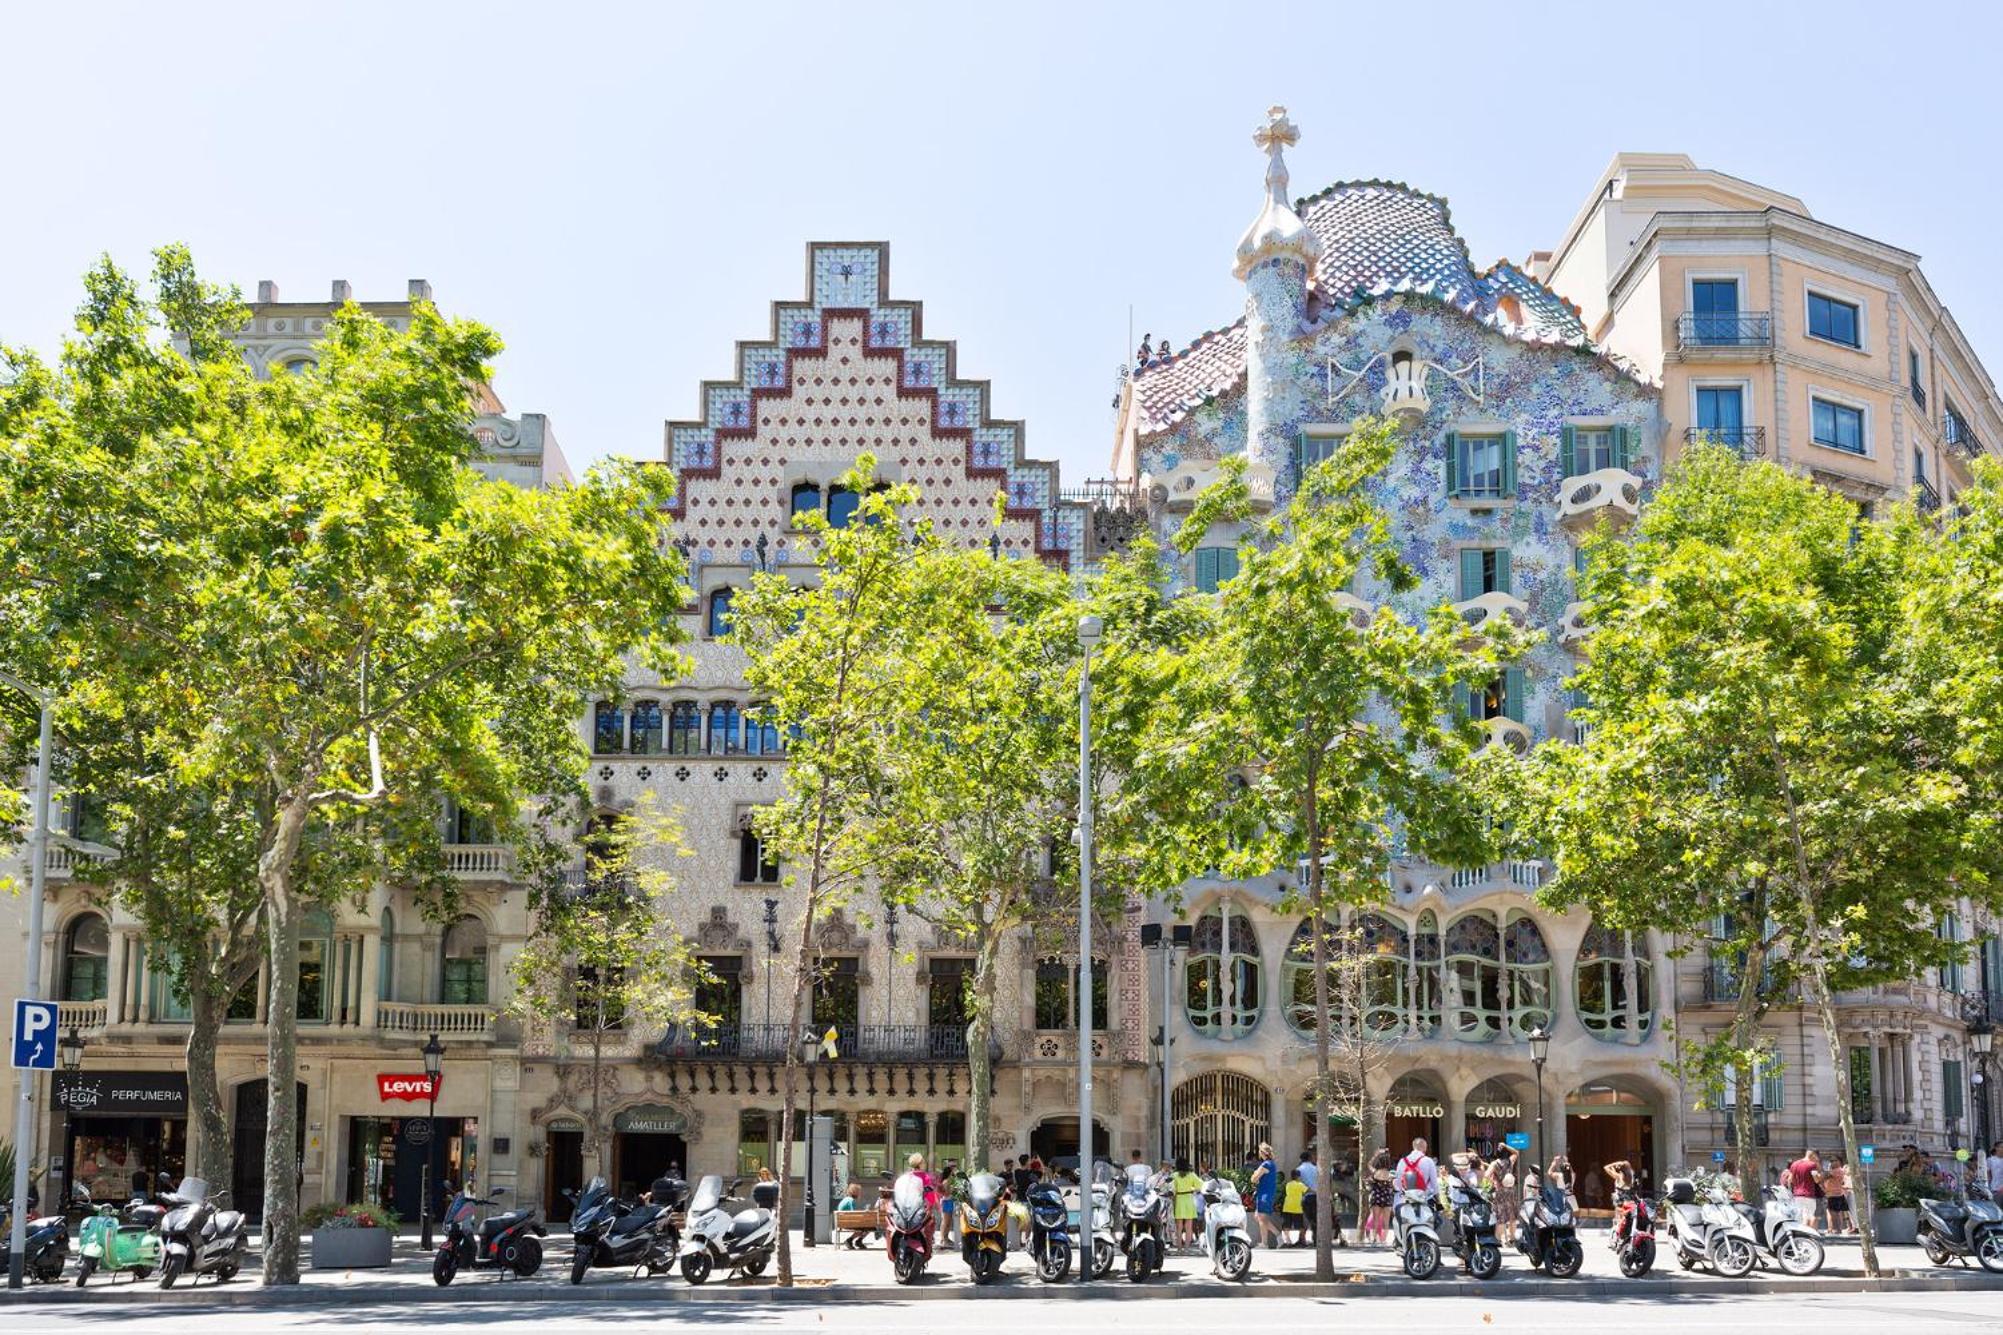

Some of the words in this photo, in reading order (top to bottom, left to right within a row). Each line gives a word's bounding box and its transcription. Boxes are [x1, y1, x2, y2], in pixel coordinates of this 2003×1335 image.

[24, 1005, 51, 1040] P
[111, 1089, 182, 1101] PERFUMERIA
[1328, 1104, 1359, 1117] ASA
[1394, 1103, 1444, 1118] BATLLÓ
[1475, 1104, 1521, 1118] GAUDÍ
[628, 1121, 676, 1130] AMATLLER
